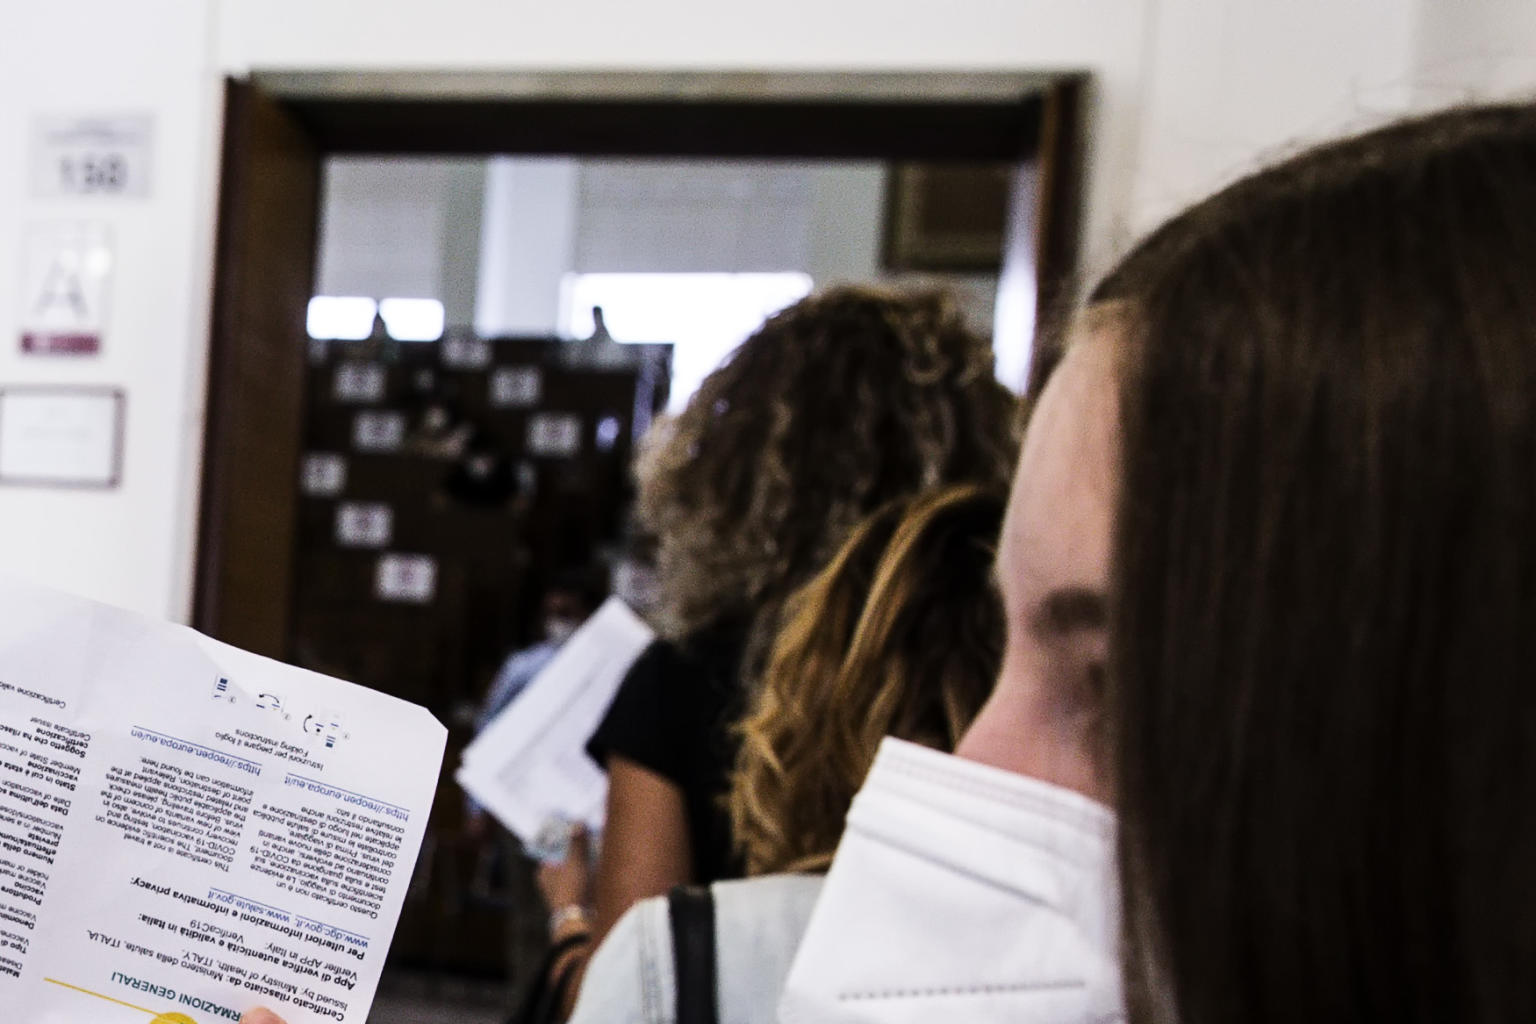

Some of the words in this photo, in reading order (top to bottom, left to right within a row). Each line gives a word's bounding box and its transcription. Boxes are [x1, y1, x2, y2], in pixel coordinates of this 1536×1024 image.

[2, 841, 22, 853] della
[22, 848, 55, 865] Numero
[172, 890, 230, 916] informativa
[179, 926, 216, 945] validità
[189, 919, 244, 944] VerificaC19
[239, 912, 303, 941] informazioni
[304, 933, 345, 952] ulteriori
[156, 952, 179, 966] della
[226, 941, 281, 965] autenticità
[299, 956, 323, 969] APP
[346, 947, 366, 961] Per
[180, 960, 224, 982] Ministero
[281, 959, 319, 978] verifica
[323, 962, 358, 982] Verifier
[111, 971, 176, 1000] GENERALI
[243, 981, 291, 1002] rilasciato
[260, 974, 299, 995] Ministry
[333, 975, 356, 991] App
[178, 993, 242, 1022] RMAZIONI
[292, 997, 345, 1022] Certificato
[315, 993, 349, 1012] Issued
